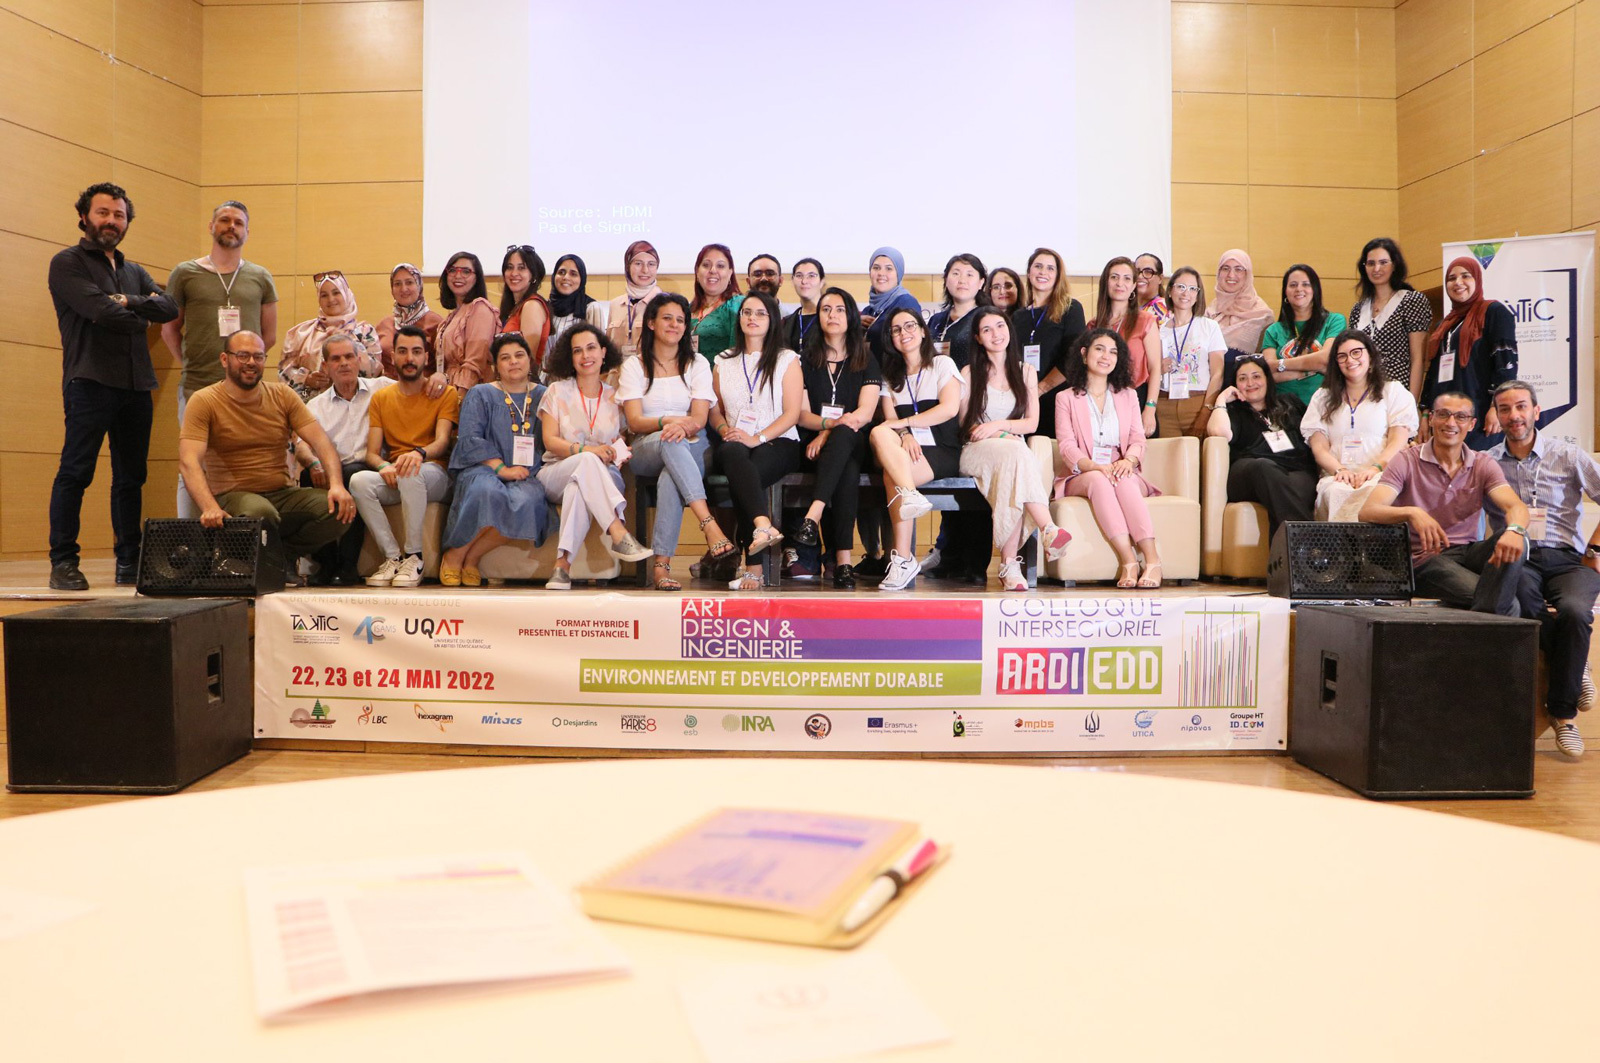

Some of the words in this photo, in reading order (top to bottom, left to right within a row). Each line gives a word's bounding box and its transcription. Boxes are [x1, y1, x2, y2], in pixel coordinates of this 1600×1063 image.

[538, 207, 601, 218] Source:
[612, 206, 652, 218] HDMI
[538, 221, 567, 233] Pas
[573, 221, 592, 233] de
[598, 221, 651, 235] Signal.
[682, 598, 725, 617] ART
[999, 598, 1162, 617] COLLOQUE
[404, 618, 464, 639] UQAT
[556, 619, 591, 627] FORMAT
[593, 620, 630, 628] HYBRIDE
[683, 618, 769, 638] DESIGN
[778, 620, 796, 638] &
[999, 620, 1161, 638] INTERSECTORIEL
[518, 629, 567, 637] PRESENTIEL
[581, 630, 630, 638] DISTANCIEL
[682, 639, 803, 658] INGENIERIE
[292, 666, 319, 687] 22,
[325, 667, 347, 687] 23
[353, 669, 372, 687] et
[378, 668, 400, 688] 24
[406, 669, 441, 689] MAI
[447, 670, 495, 690] 2022
[583, 668, 717, 686] ENVIRONNEMENT
[721, 670, 736, 686] ET
[741, 671, 870, 688] DEVELOPPEMENT
[875, 672, 944, 688] DURABLE
[1001, 652, 1080, 690] ARDI
[1092, 651, 1159, 690] EDD
[372, 715, 388, 724] LBC
[418, 713, 453, 721] hexagram
[481, 711, 523, 724] Mitacs
[563, 719, 598, 727] Desjardins
[741, 715, 776, 732] INRA
[1024, 720, 1054, 729] mpbs
[683, 728, 698, 736] esb
